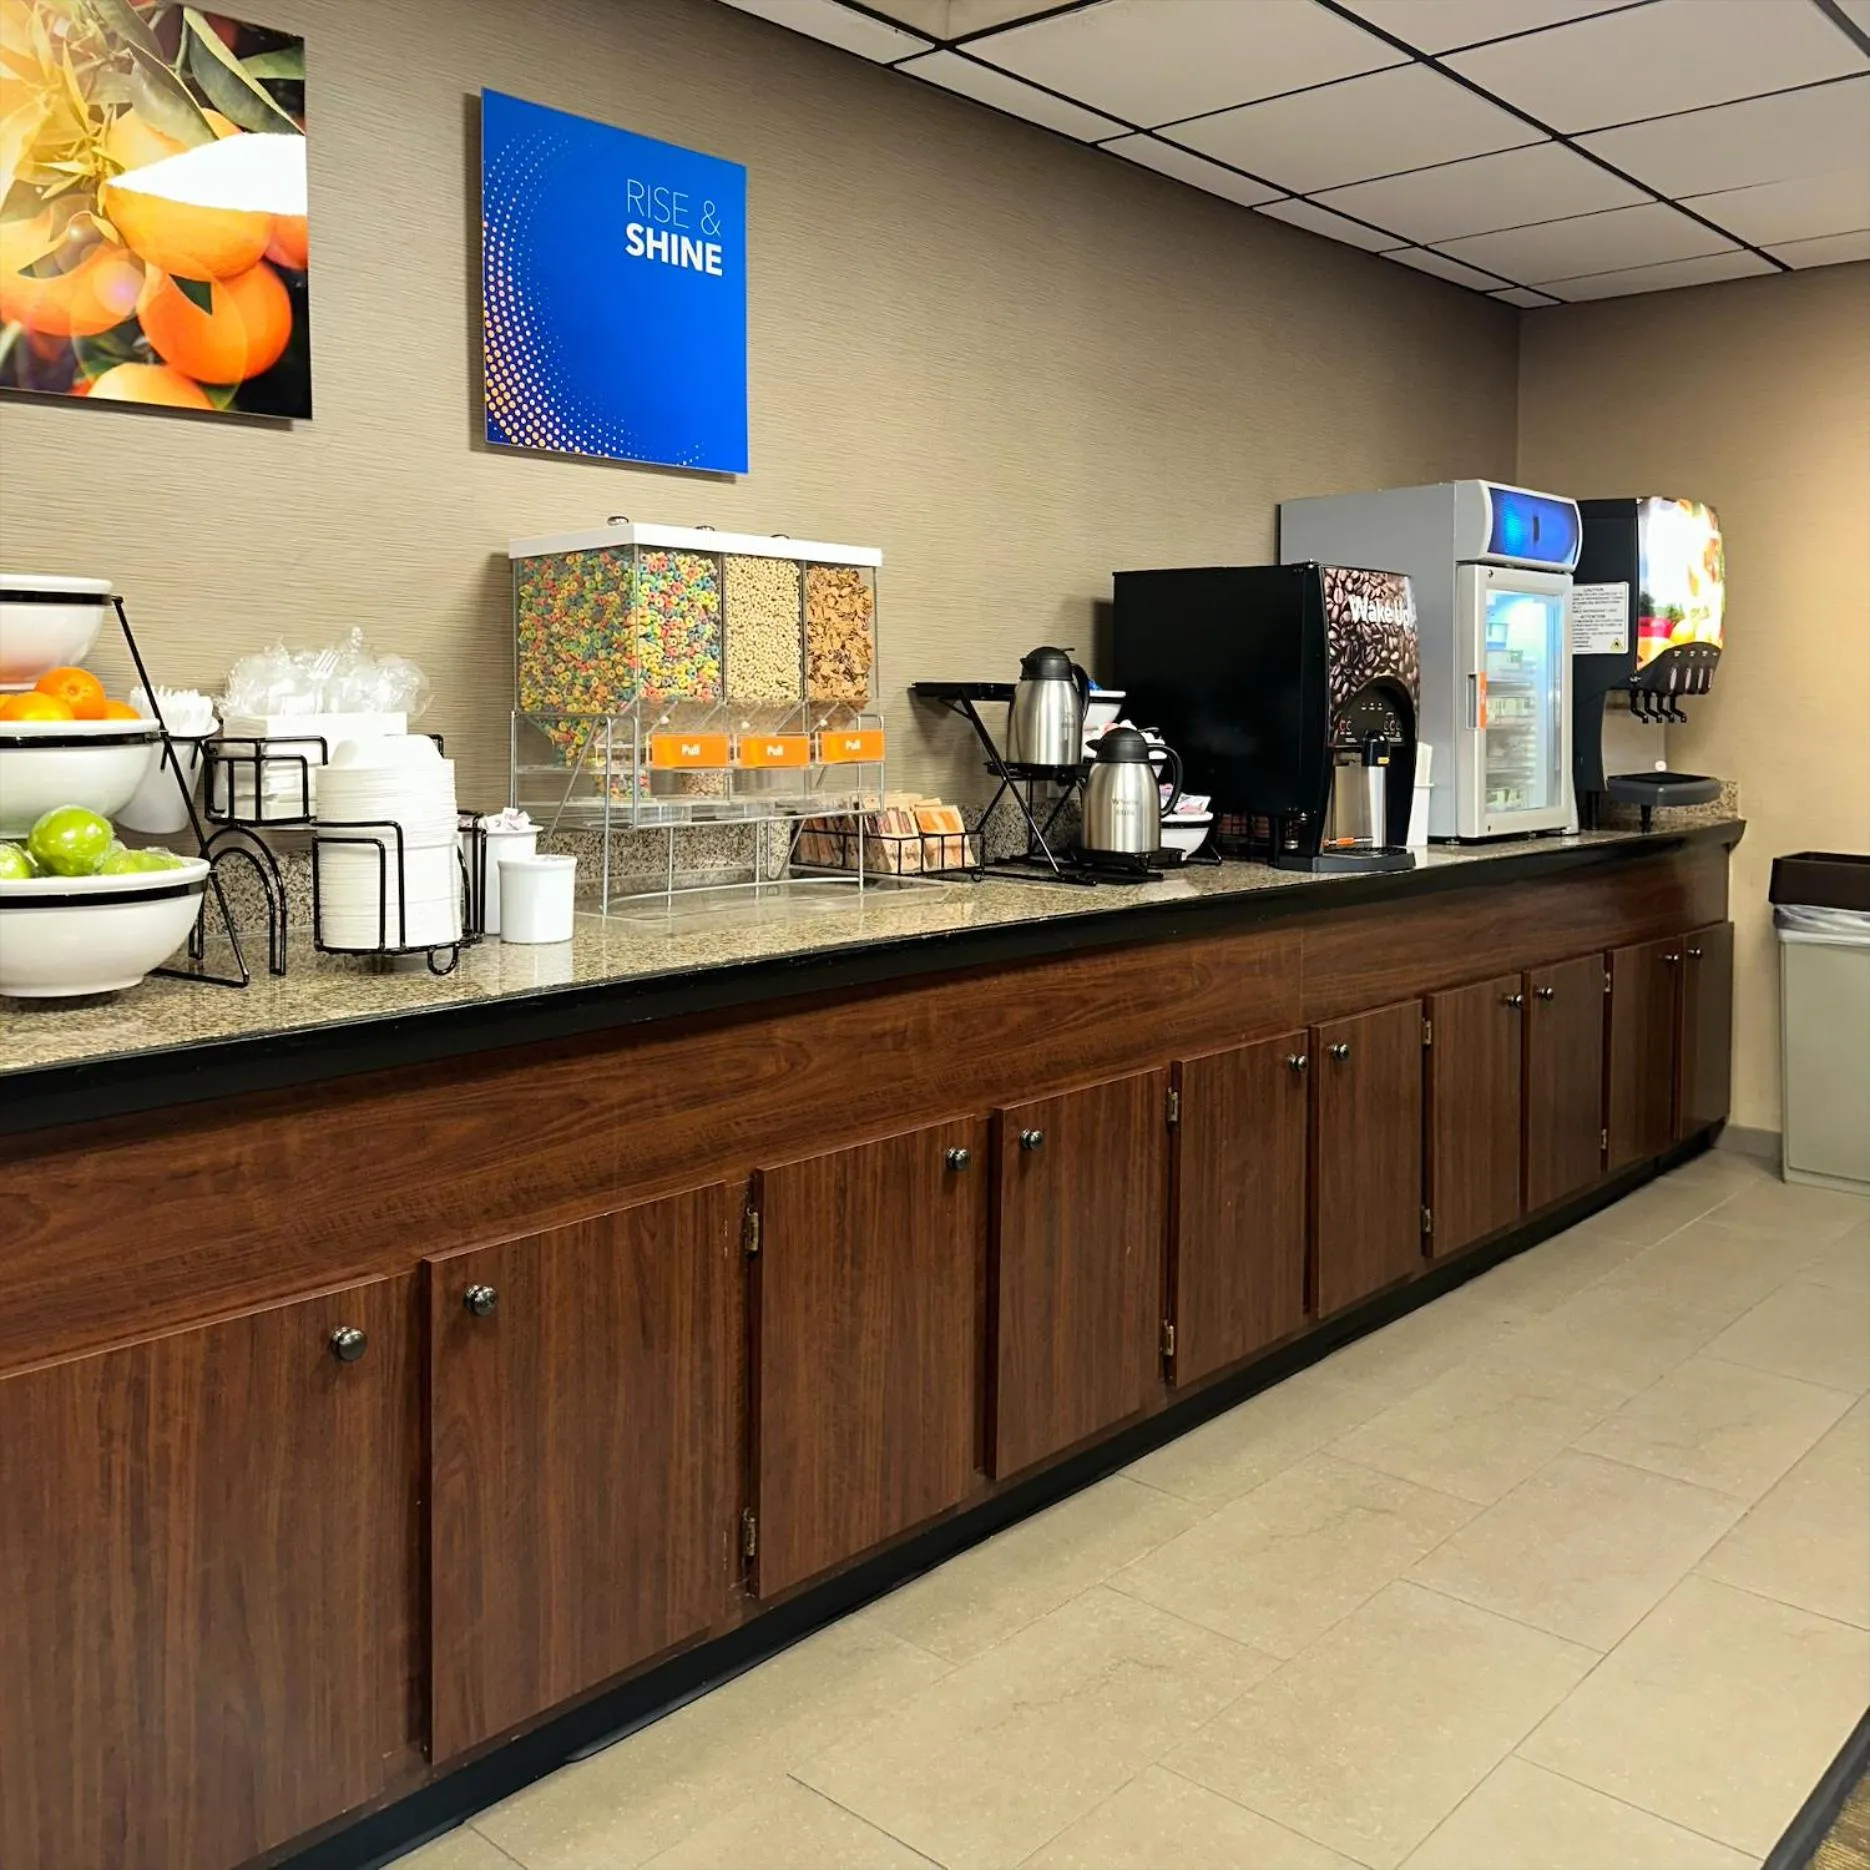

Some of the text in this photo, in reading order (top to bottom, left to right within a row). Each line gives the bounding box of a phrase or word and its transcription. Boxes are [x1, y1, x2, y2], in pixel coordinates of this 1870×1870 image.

[627, 178, 721, 237] RISE &
[625, 222, 723, 277] SHINE
[1348, 593, 1393, 625] Wake
